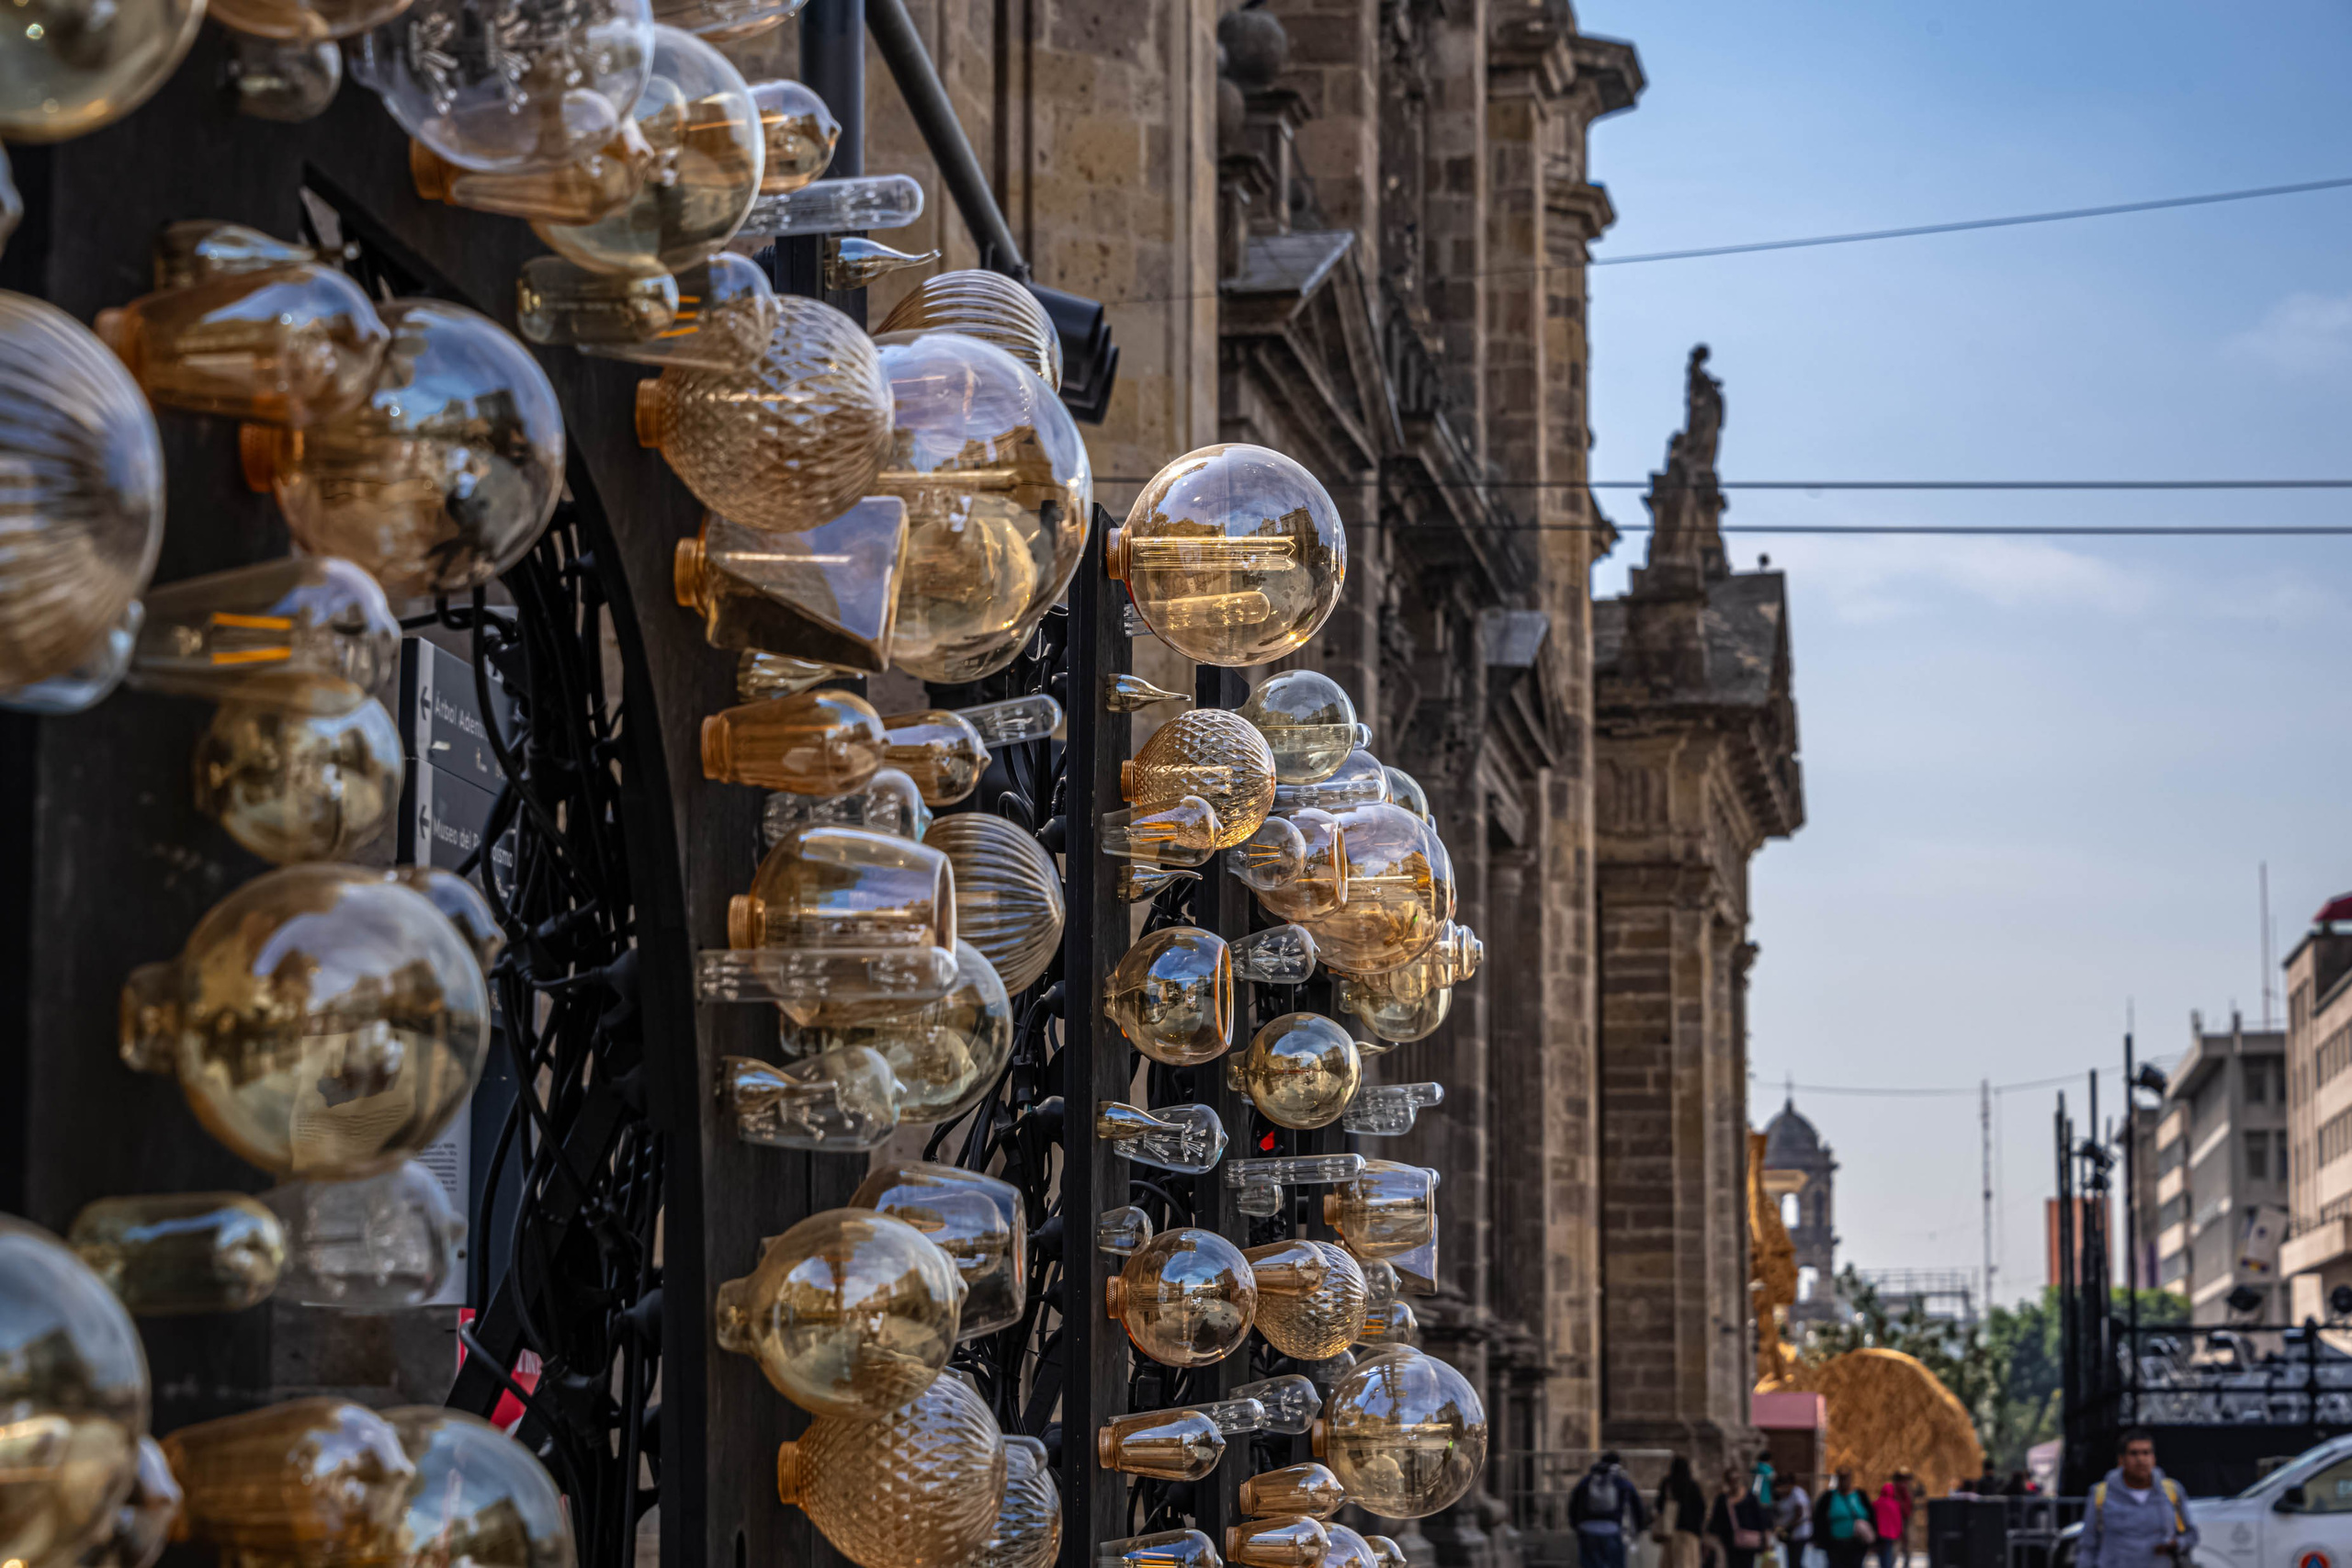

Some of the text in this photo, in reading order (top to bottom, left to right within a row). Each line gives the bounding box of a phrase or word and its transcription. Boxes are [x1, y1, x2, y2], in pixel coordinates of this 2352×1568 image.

[435, 690, 458, 726] Árbol
[433, 817, 458, 845] Museo
[459, 827, 472, 851] del
